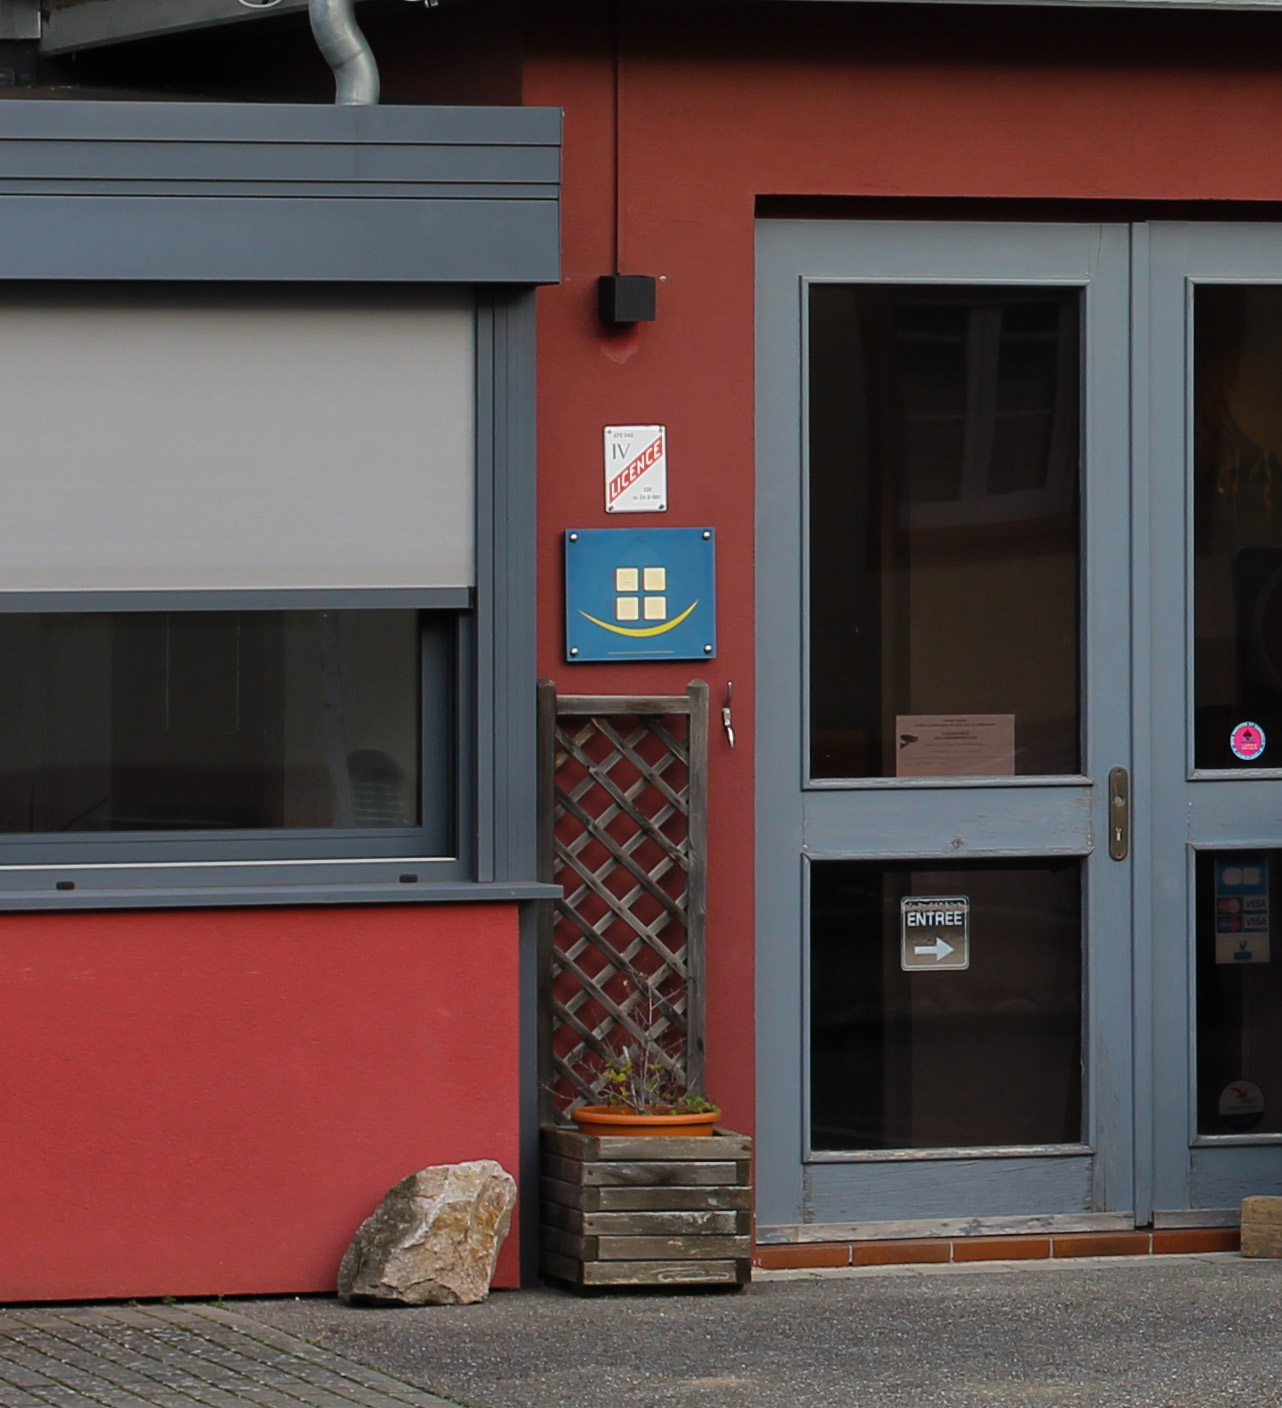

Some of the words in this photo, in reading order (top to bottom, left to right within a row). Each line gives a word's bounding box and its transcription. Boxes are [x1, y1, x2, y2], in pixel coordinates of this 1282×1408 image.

[612, 443, 631, 460] IV
[611, 439, 662, 500] LICENCE
[907, 910, 963, 927] ENTREE
